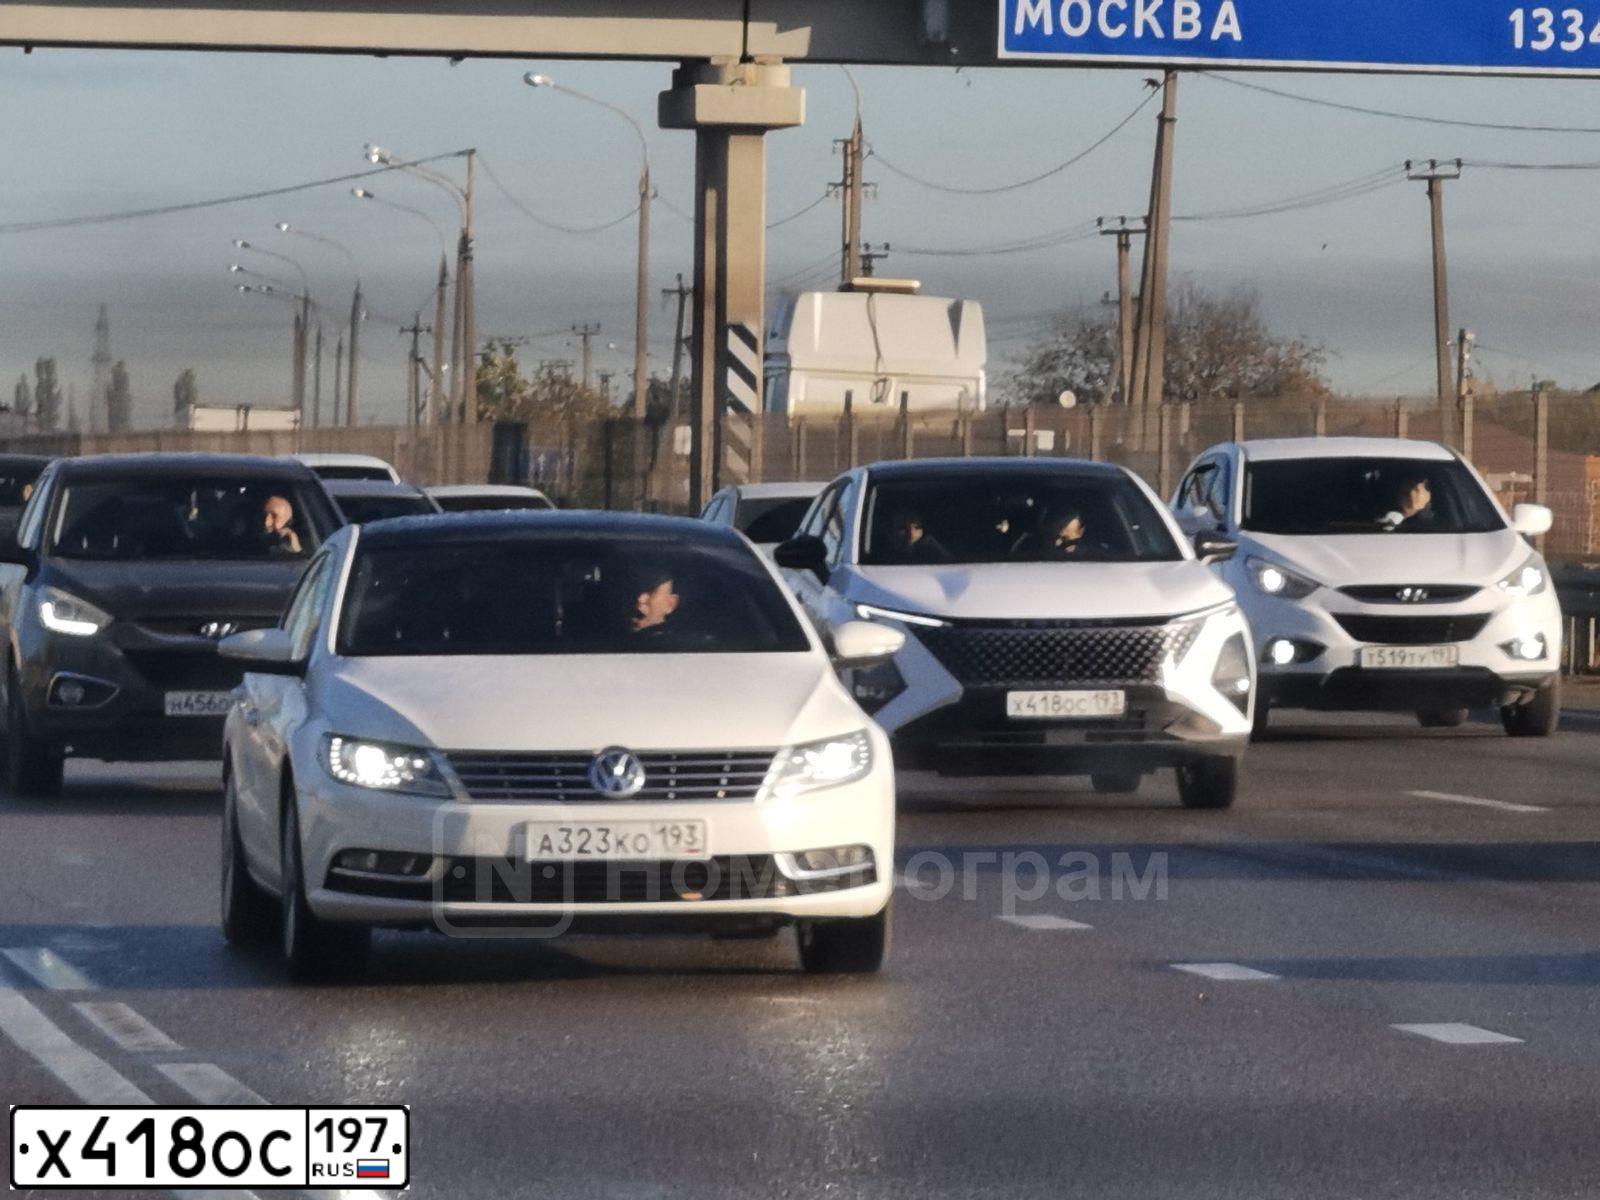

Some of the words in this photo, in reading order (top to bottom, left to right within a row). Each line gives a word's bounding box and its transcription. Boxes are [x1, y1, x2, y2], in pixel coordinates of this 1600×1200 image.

[1014, 0, 1242, 42] МОСКВА
[537, 827, 650, 855] А323КО
[656, 824, 698, 847] 193
